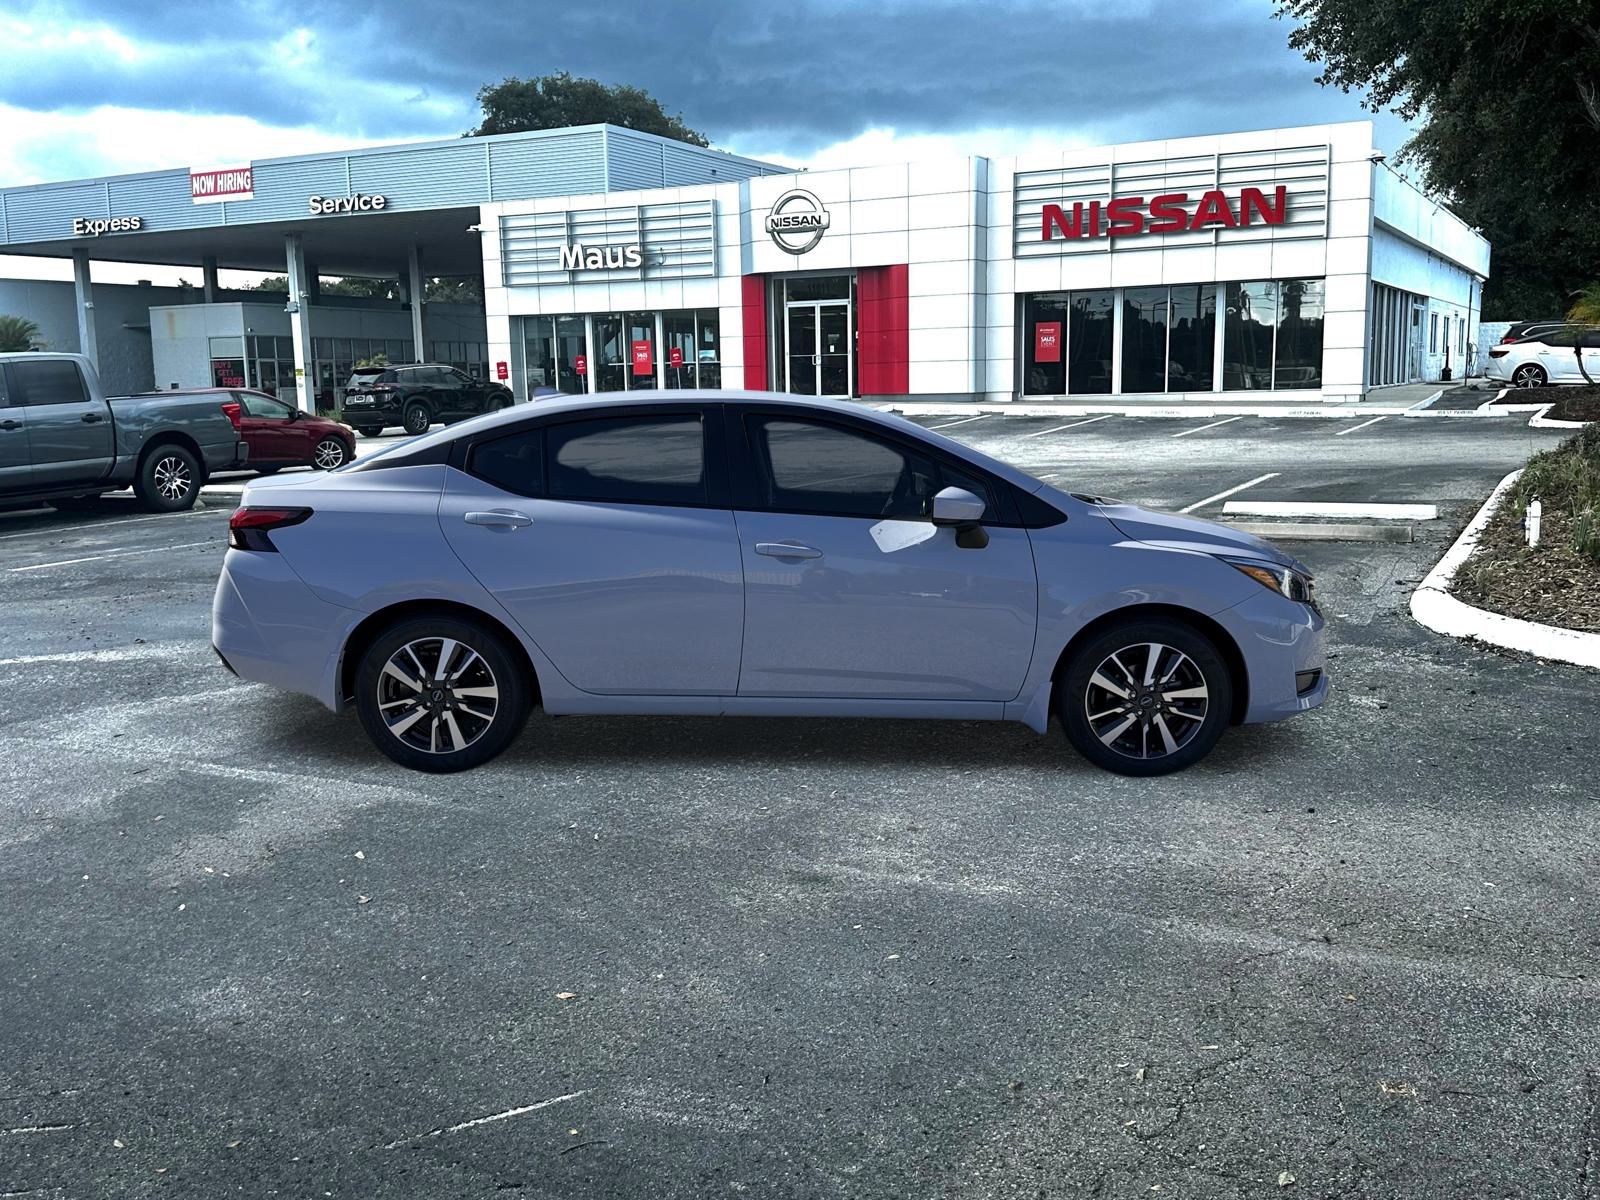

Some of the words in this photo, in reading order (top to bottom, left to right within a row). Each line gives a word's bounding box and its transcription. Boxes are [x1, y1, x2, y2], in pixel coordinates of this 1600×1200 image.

[192, 174, 215, 195] NOW
[217, 171, 251, 192] HIRING
[308, 193, 386, 215] Service
[1042, 185, 1287, 241] NISSAN
[72, 215, 141, 236] Express
[770, 214, 822, 229] NISSAN
[559, 243, 642, 270] Maus
[222, 377, 244, 386] FREE
